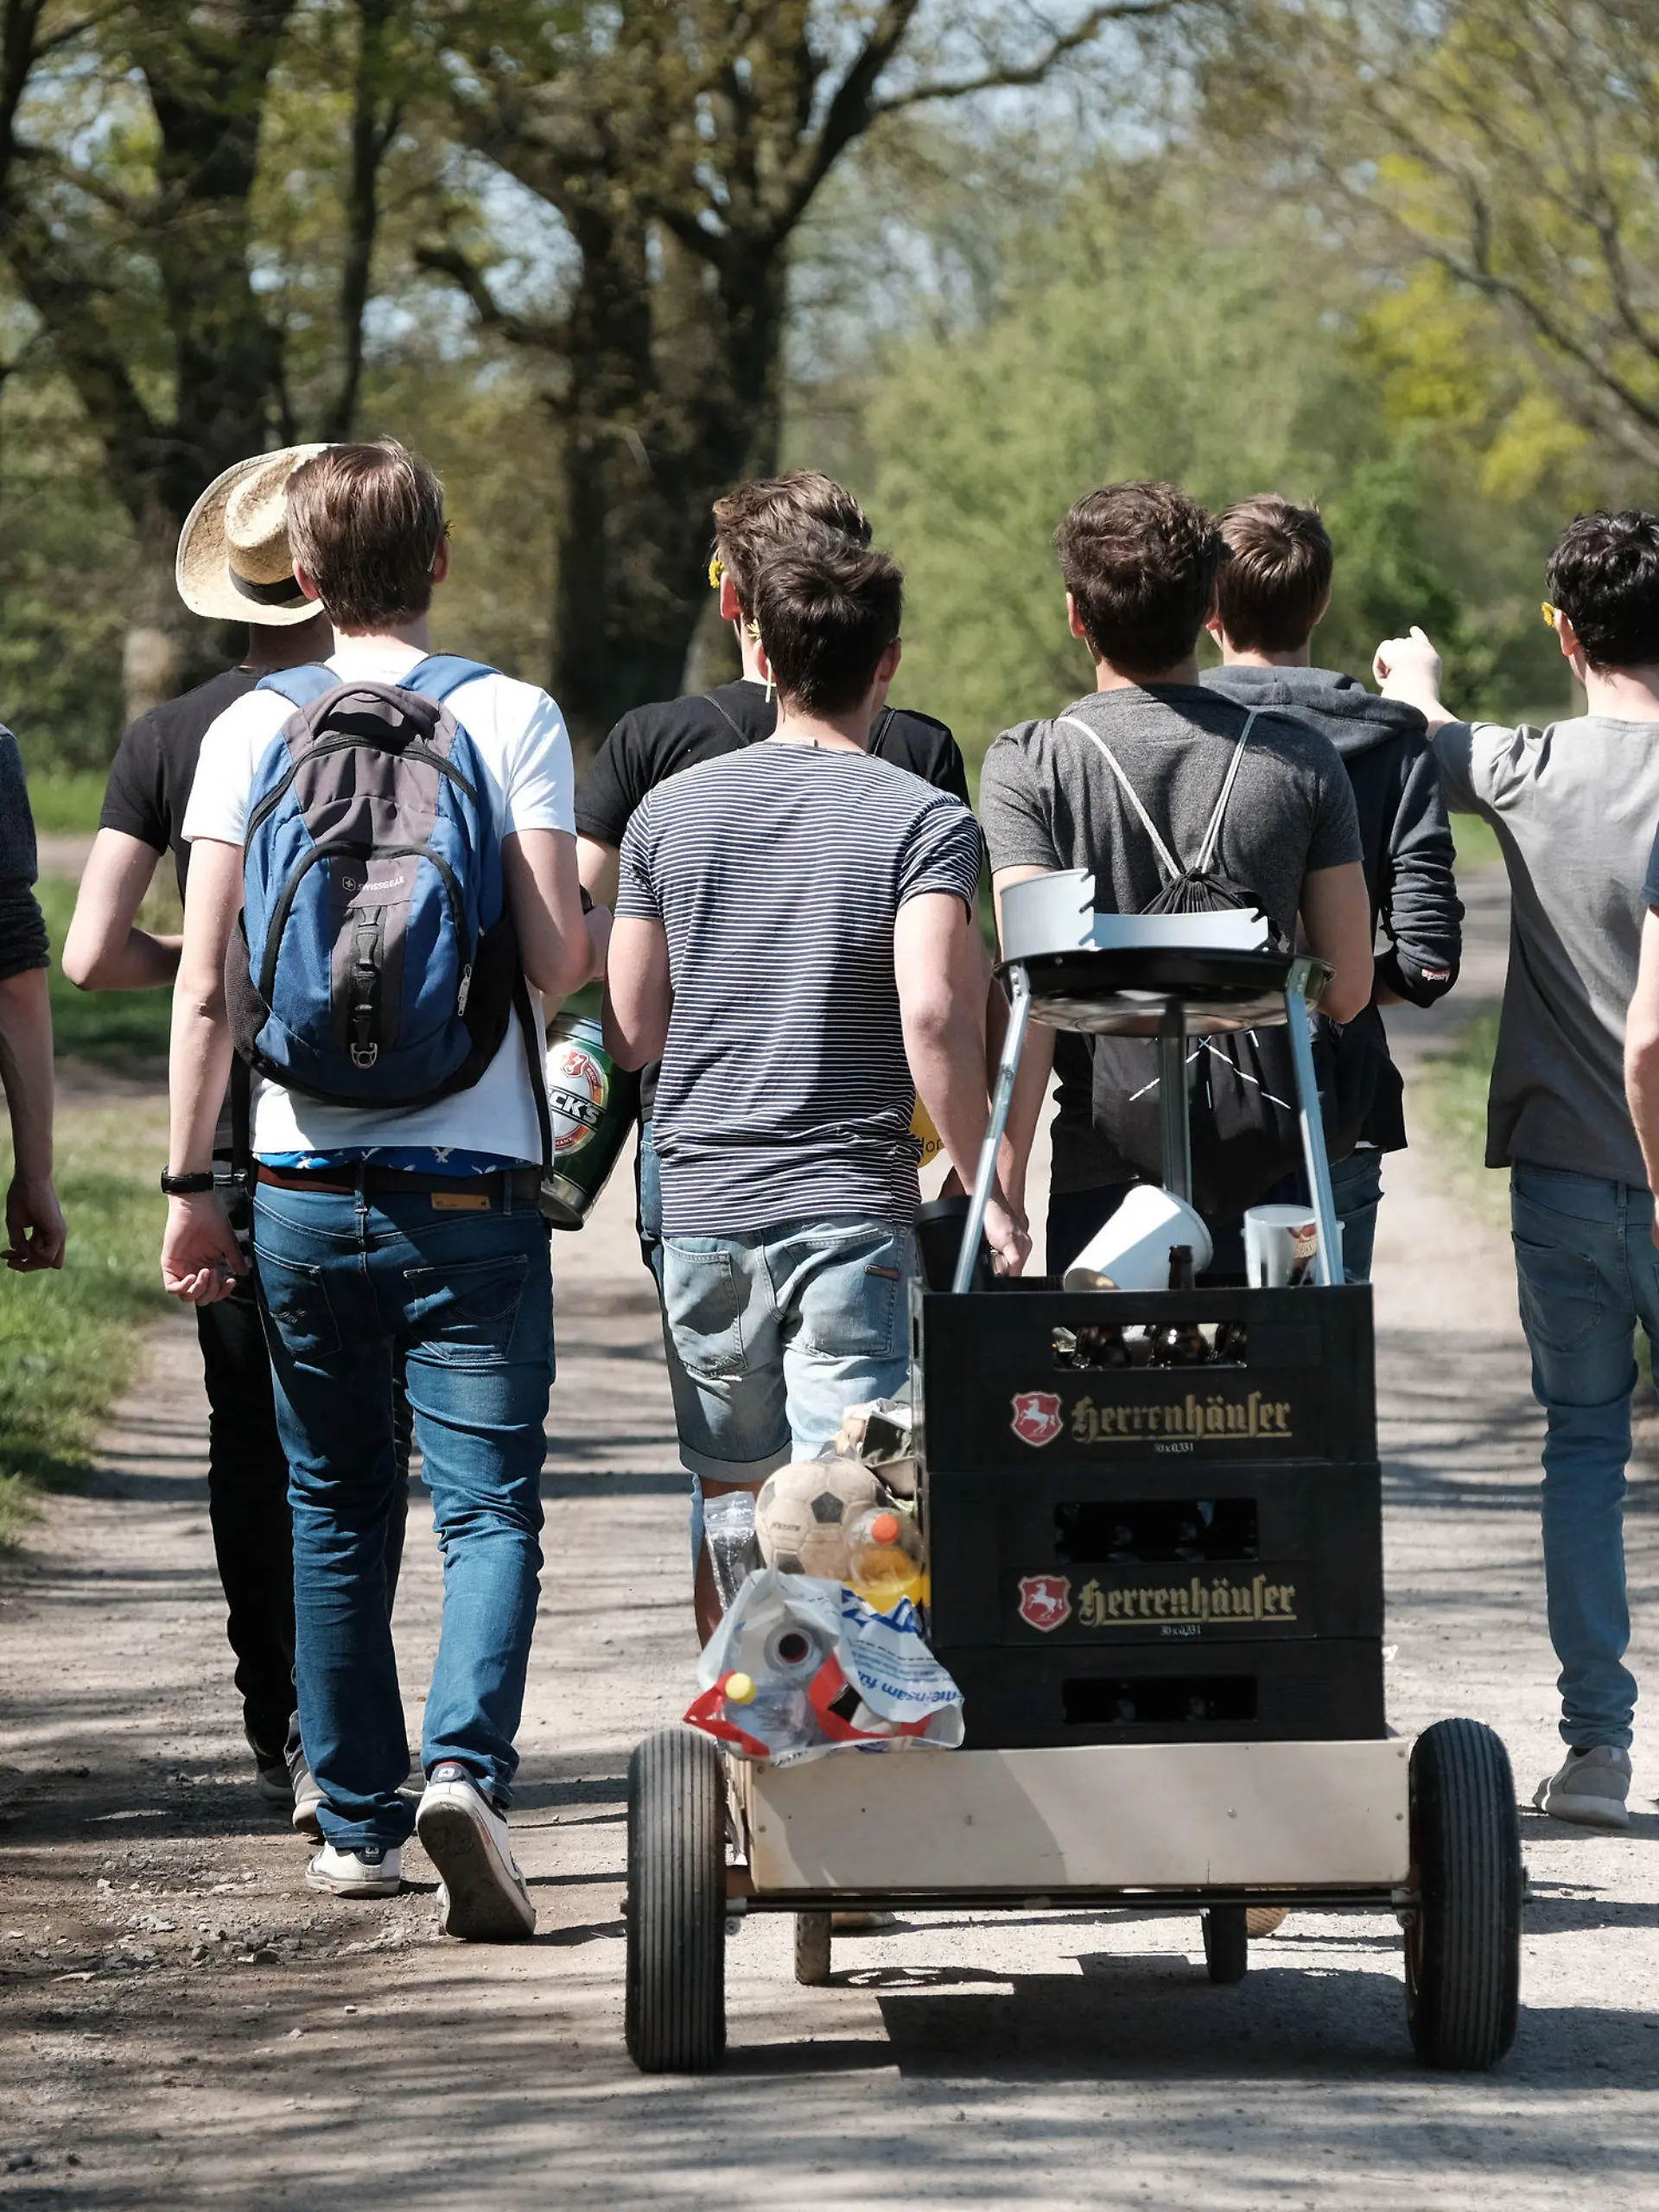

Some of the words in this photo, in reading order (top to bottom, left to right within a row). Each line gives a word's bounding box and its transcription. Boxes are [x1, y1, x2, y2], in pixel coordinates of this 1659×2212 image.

[358, 875, 404, 891] SWISSGEAR
[549, 1090, 600, 1123] CK'S
[881, 1682, 959, 1702] meinsam
